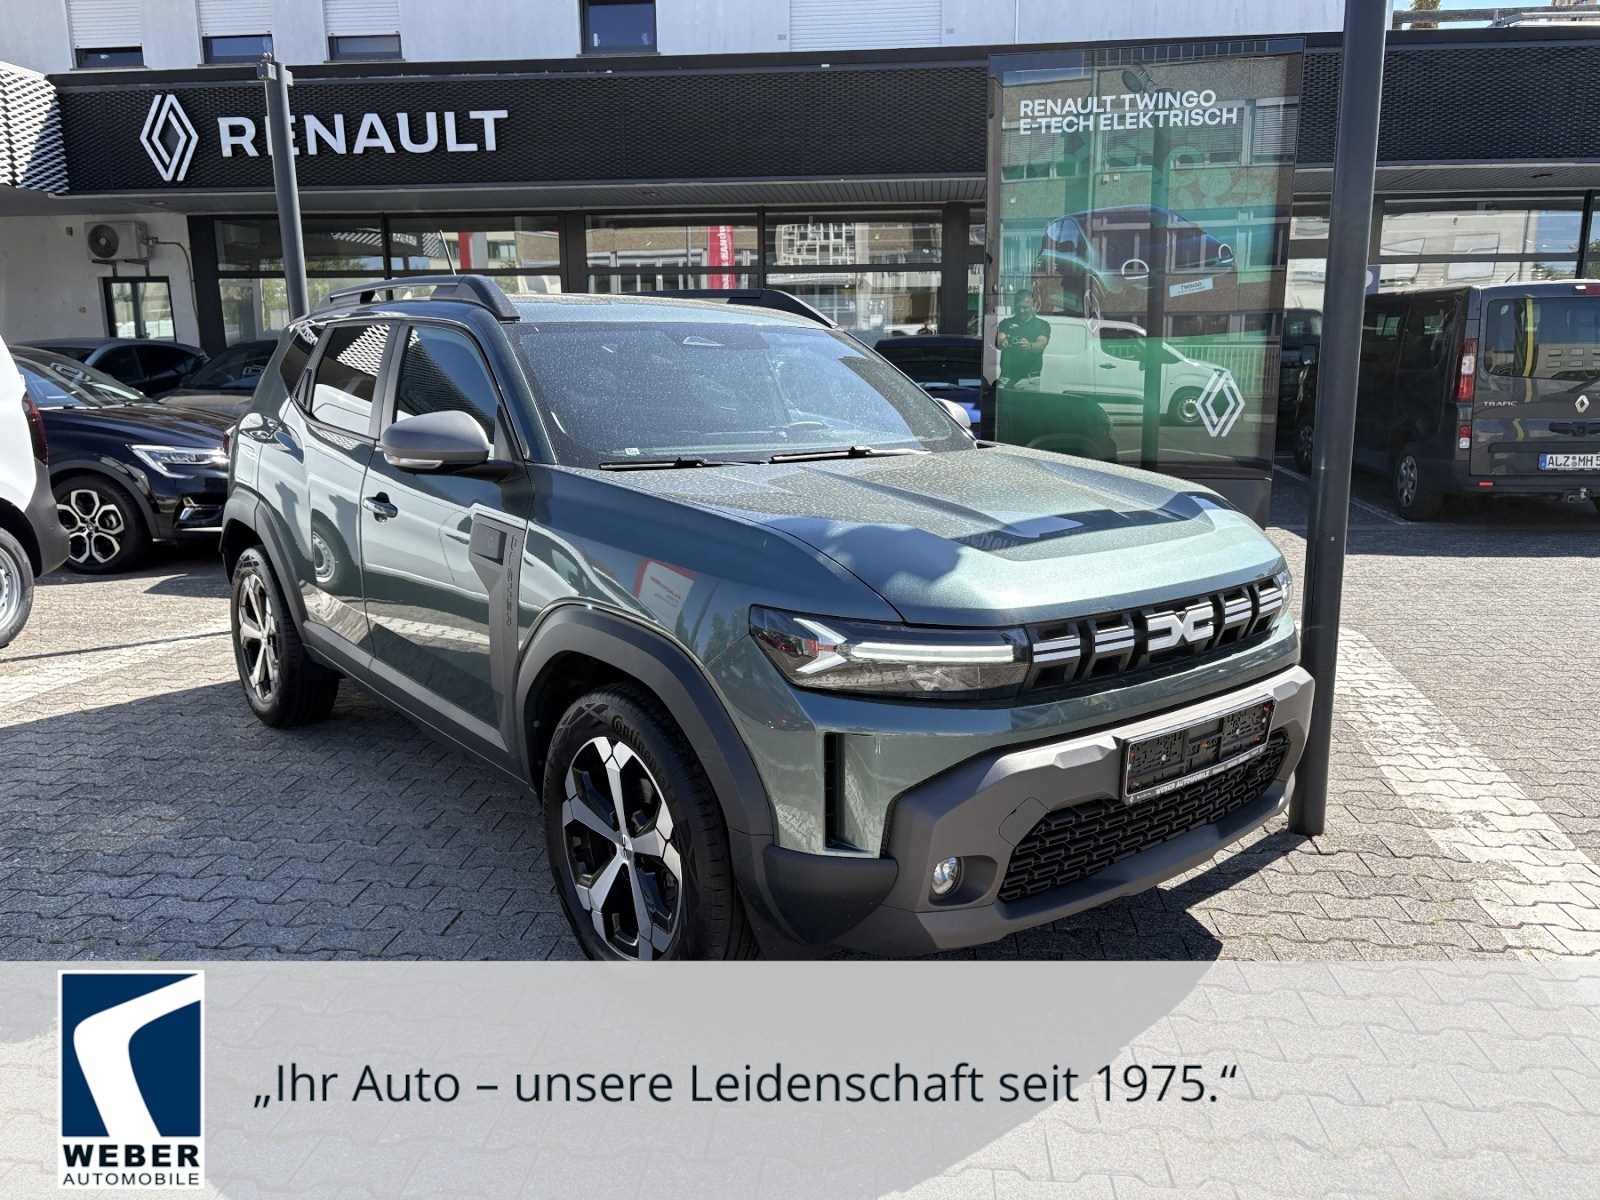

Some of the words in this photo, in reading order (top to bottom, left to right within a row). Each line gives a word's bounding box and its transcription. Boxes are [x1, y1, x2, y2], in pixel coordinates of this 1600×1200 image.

[1020, 95, 1117, 117] RENAULT
[1120, 89, 1217, 111] TWINGO
[1019, 115, 1094, 135] E-TECH
[1100, 107, 1238, 131] ELEKTRISCH
[1548, 455, 1571, 467] ALZ
[1578, 455, 1594, 467] MH
[507, 534, 518, 626] DUSTER
